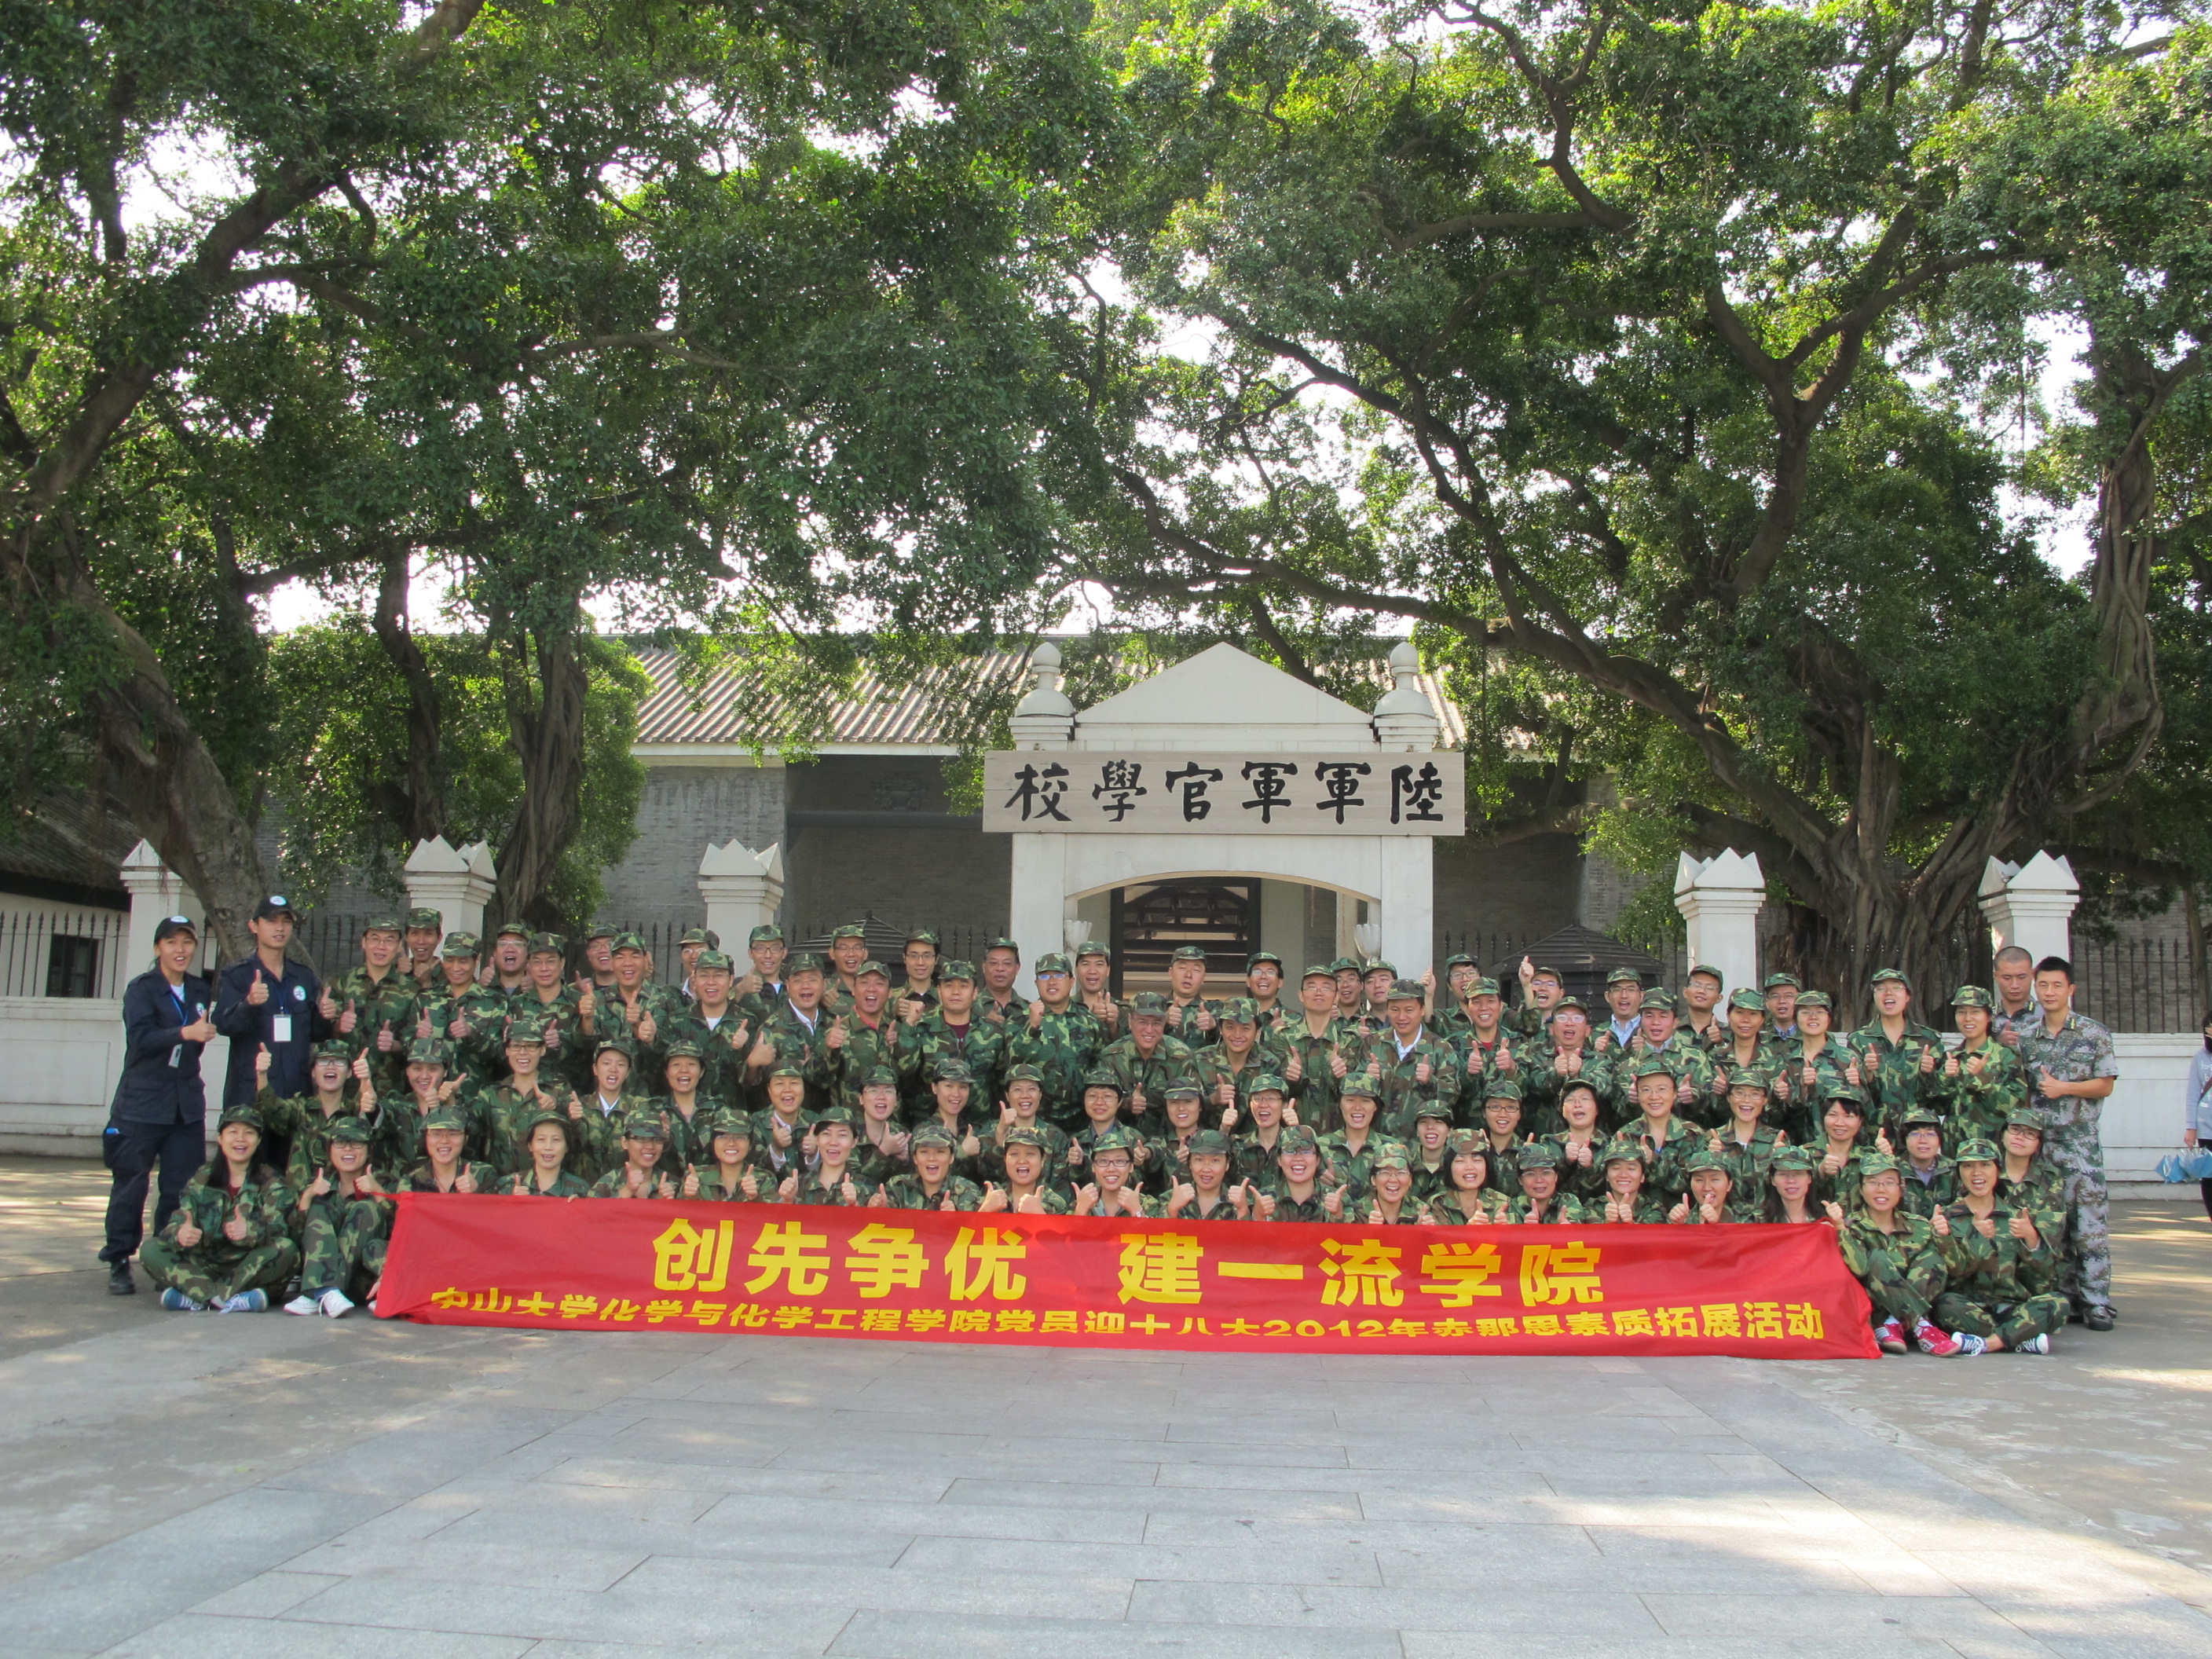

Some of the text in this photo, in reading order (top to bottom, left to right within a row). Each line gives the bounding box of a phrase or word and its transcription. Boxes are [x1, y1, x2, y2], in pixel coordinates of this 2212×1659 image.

[653, 1218, 1604, 1308] 创先争优 建一流学院
